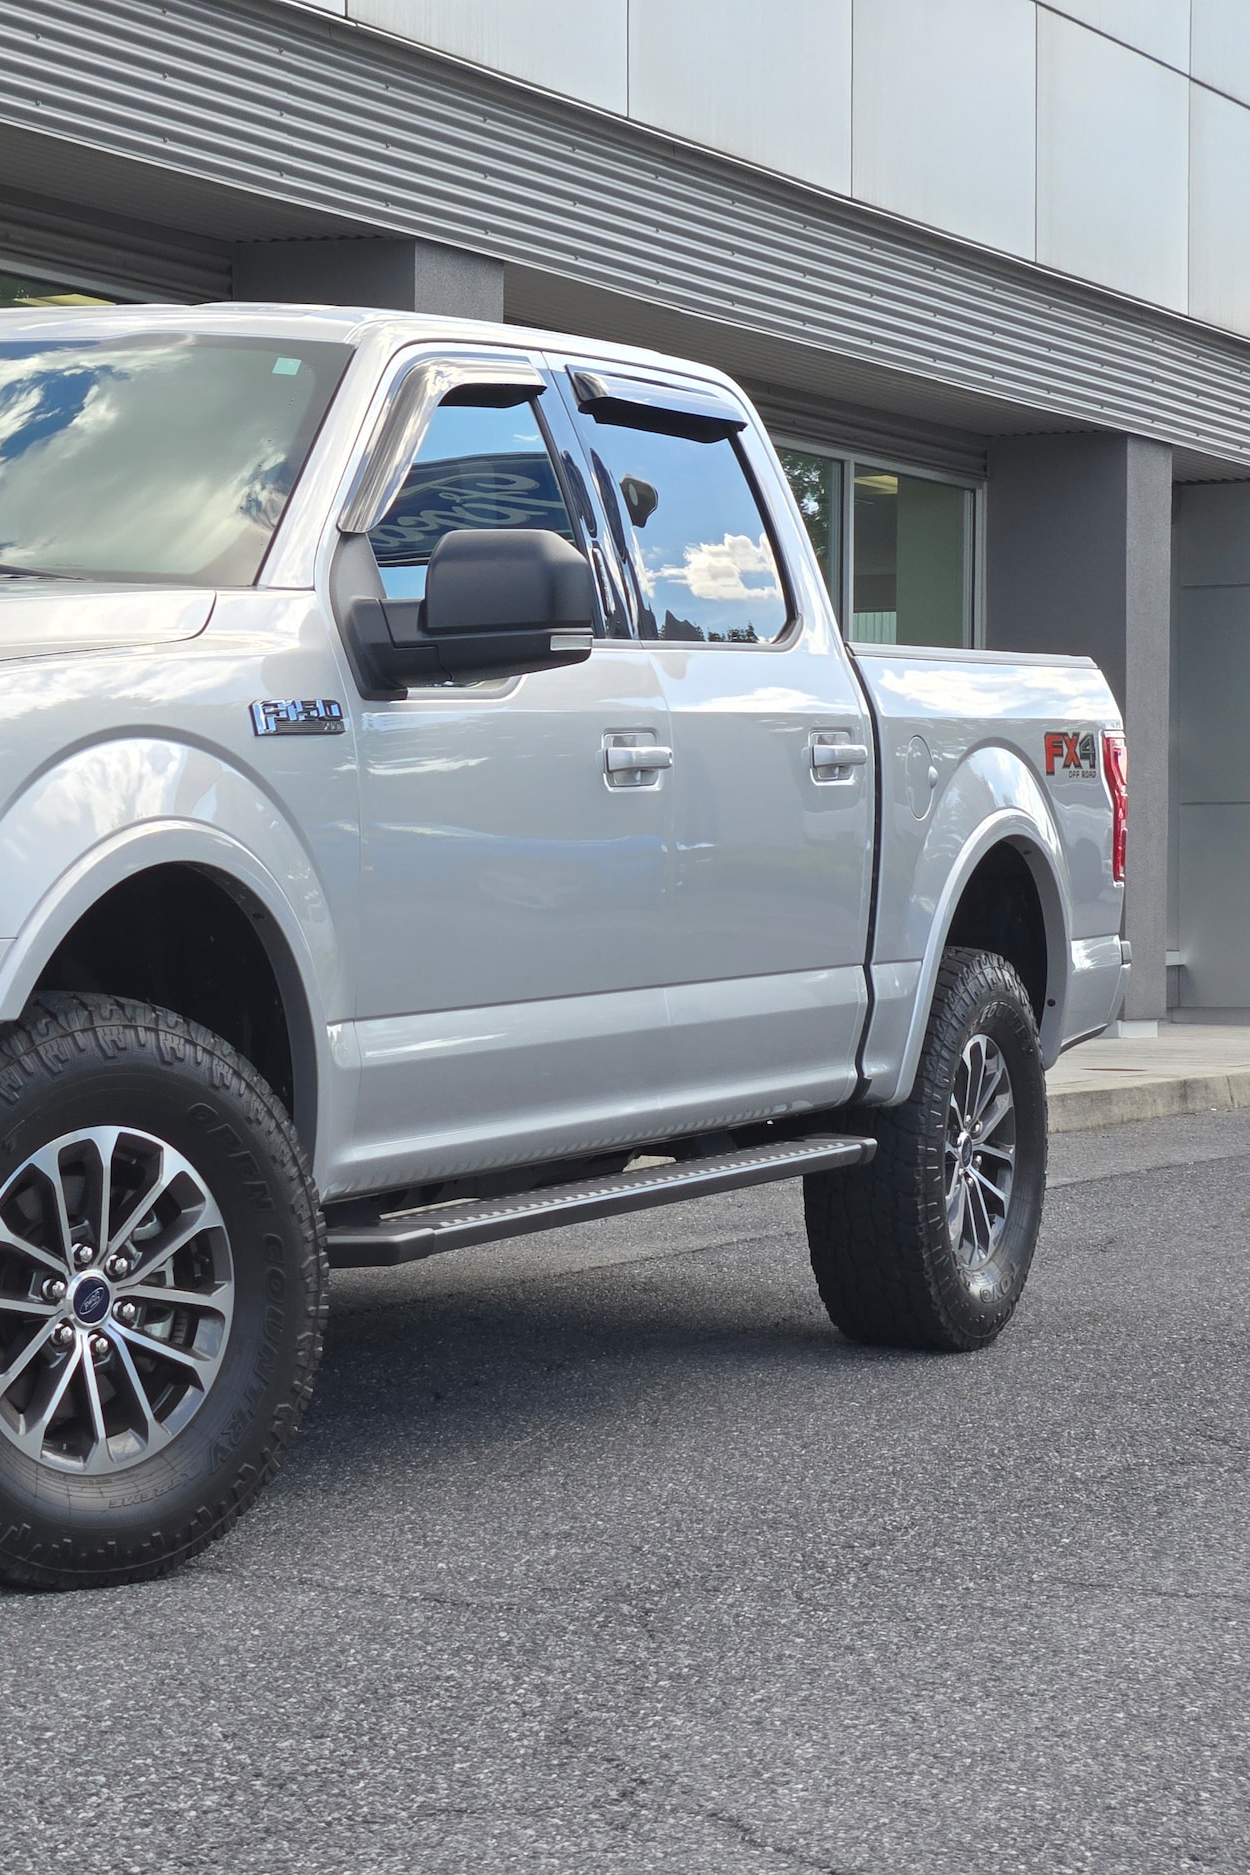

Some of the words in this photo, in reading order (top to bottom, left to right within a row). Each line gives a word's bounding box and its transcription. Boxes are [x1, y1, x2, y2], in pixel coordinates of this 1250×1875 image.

[1044, 731, 1096, 776] FX4
[1069, 770, 1080, 779] OFF
[184, 1101, 276, 1214] OPEN
